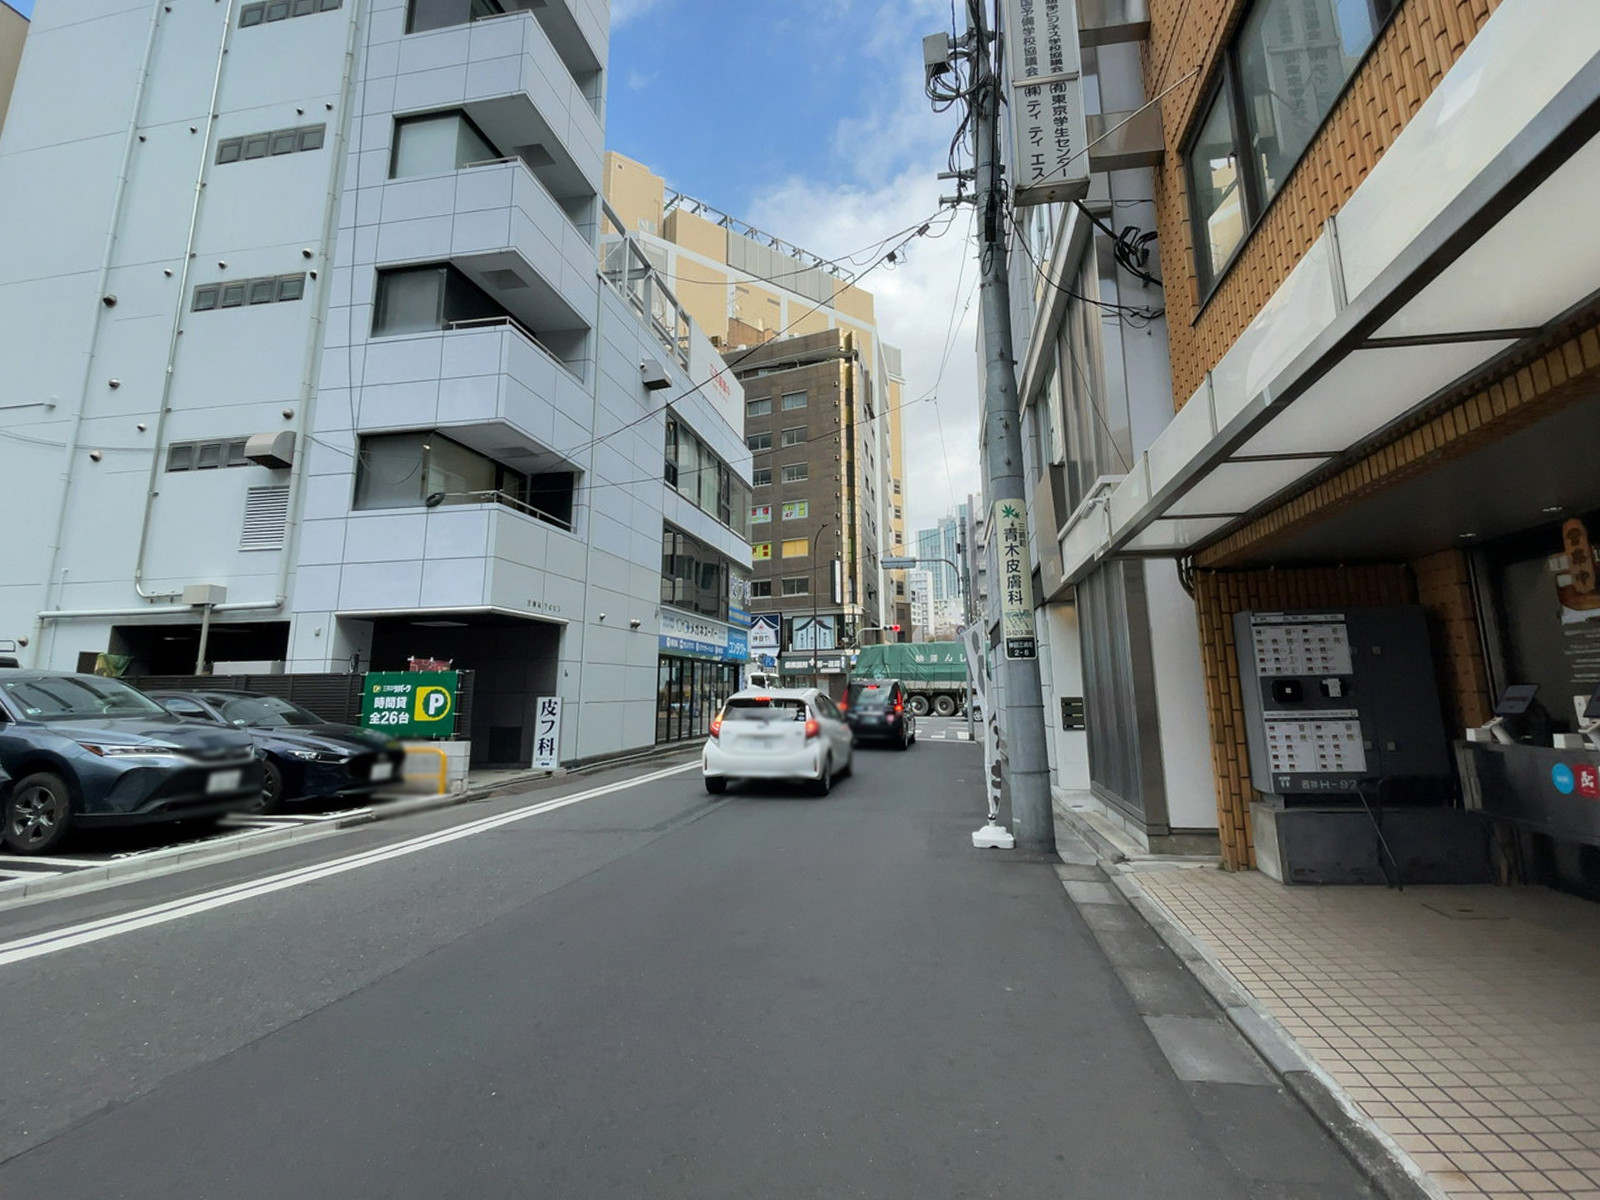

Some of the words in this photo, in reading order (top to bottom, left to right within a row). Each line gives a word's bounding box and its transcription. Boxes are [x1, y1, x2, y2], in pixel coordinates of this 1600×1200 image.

[1004, 526, 1024, 606] 青木皮膚科
[374, 696, 408, 709] 時間貸
[428, 693, 445, 715] P
[369, 711, 410, 725] 全26台
[537, 698, 558, 756] 皮フ科
